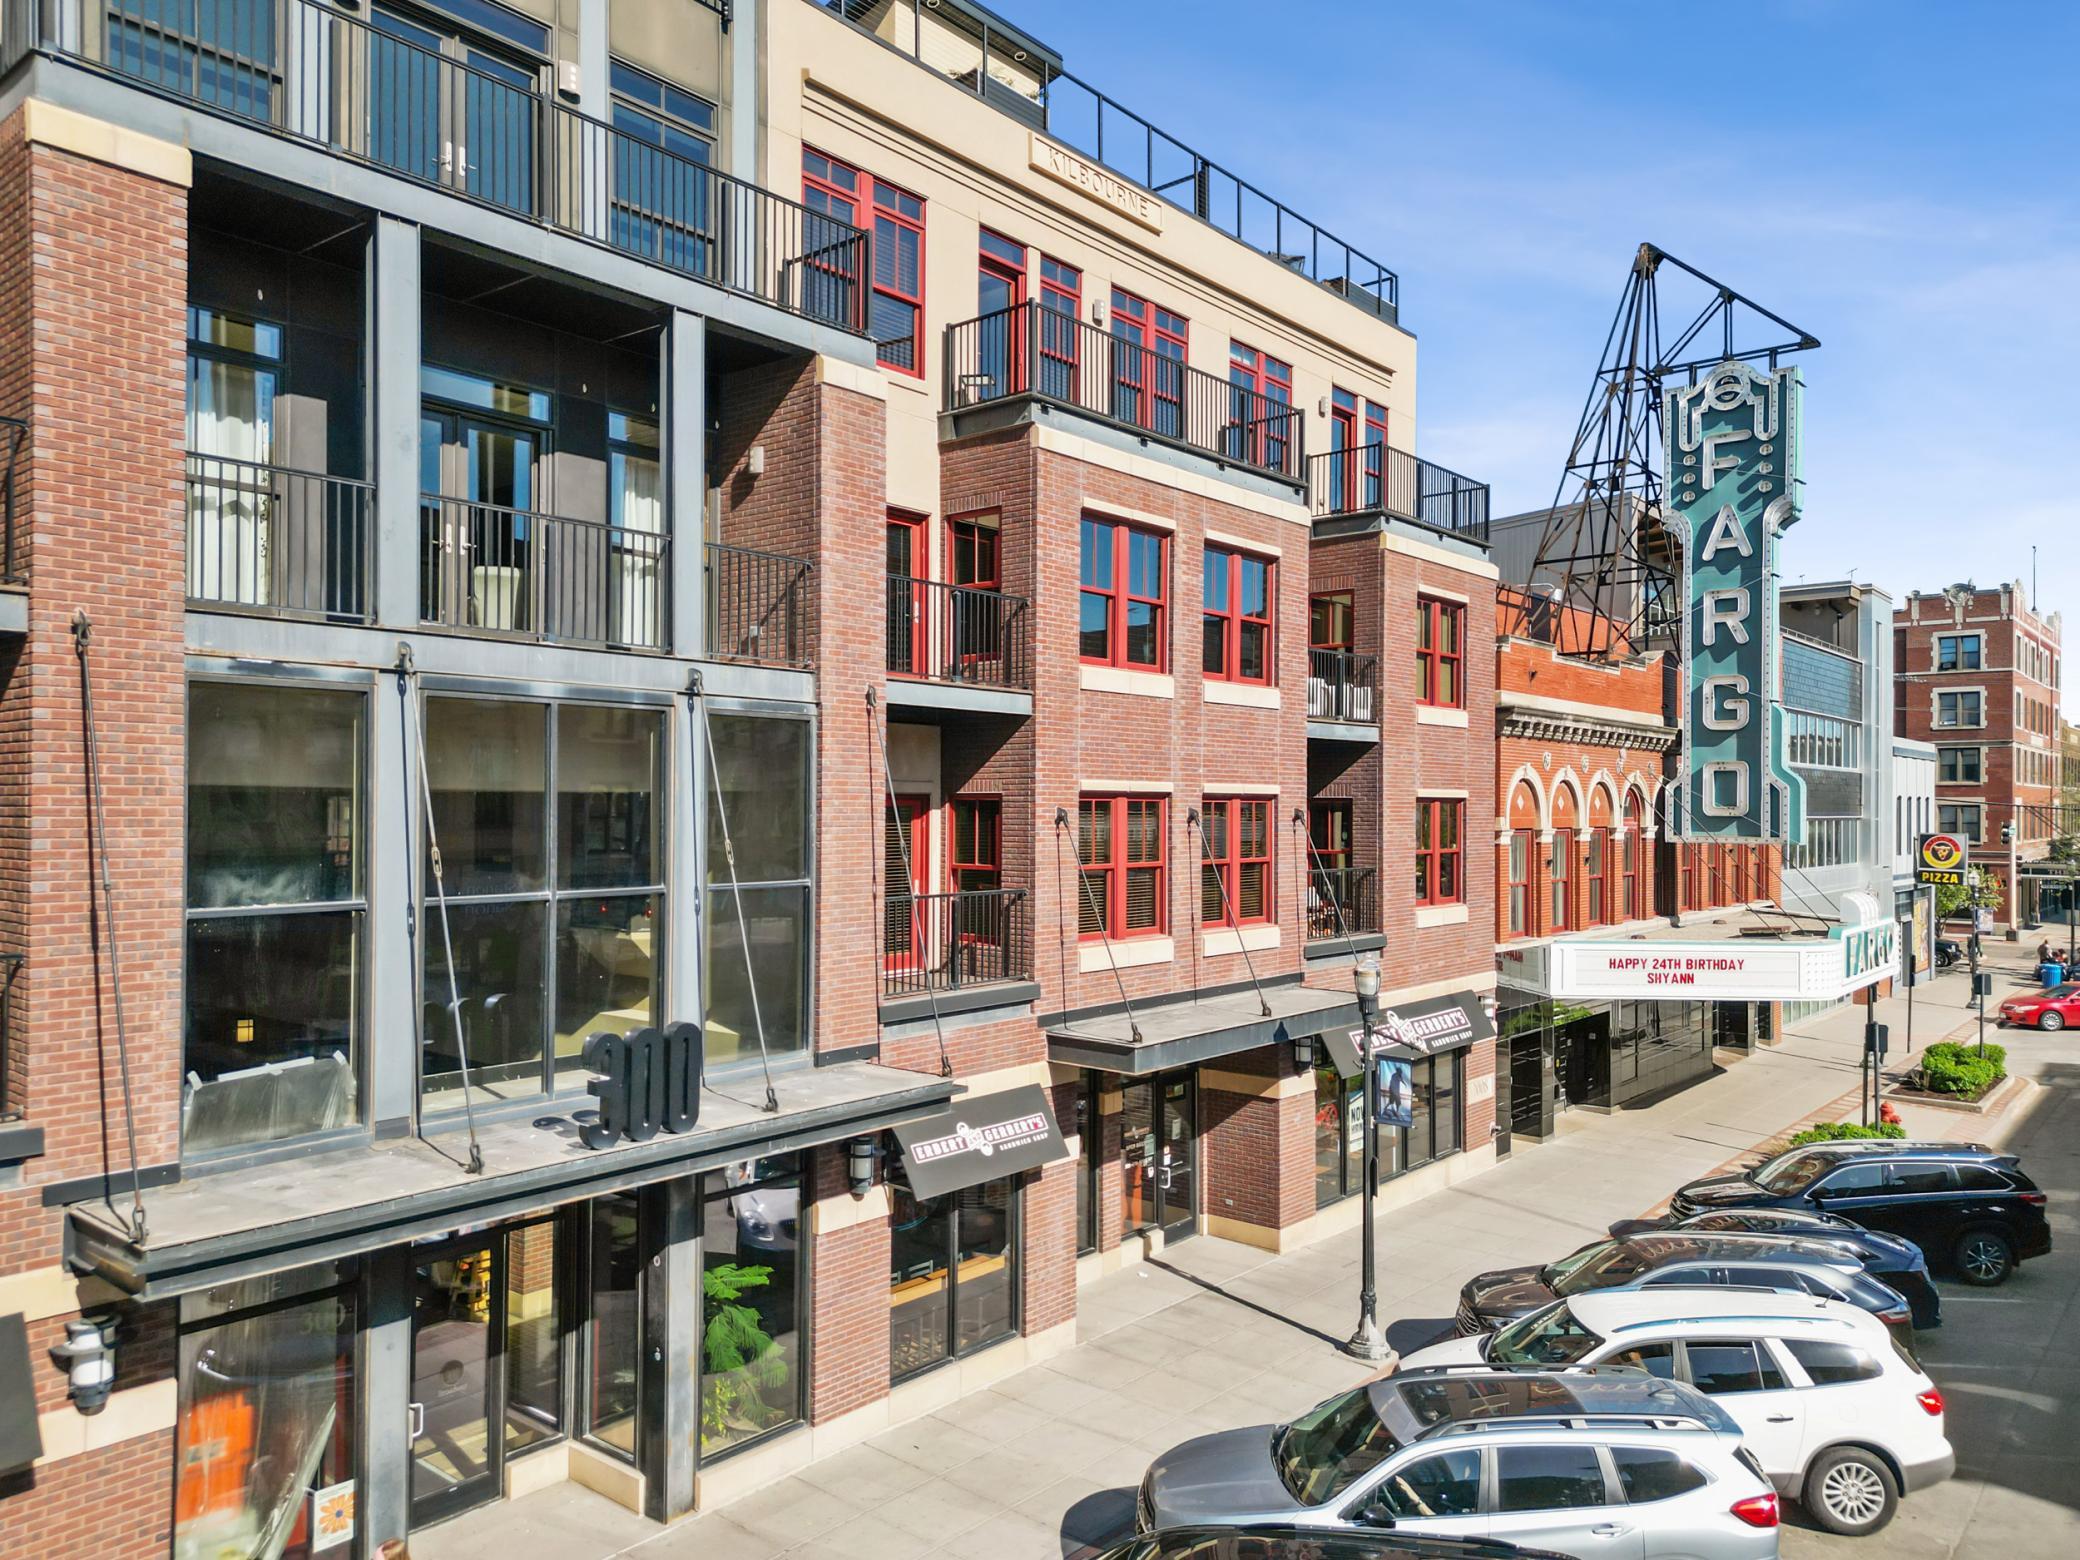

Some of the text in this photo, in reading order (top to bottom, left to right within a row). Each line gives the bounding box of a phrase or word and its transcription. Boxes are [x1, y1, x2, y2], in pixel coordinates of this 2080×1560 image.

[1049, 148, 1148, 218] KILBOURNE
[1702, 429, 1753, 817] FARGO
[1921, 871, 1959, 884] PIZZA
[1609, 958, 1744, 971] HAPPY 24TH BIRTHDAY
[1846, 924, 1894, 978] FARGO
[1647, 973, 1695, 985] SHYANN
[1354, 1027, 1398, 1049] EBERT
[1413, 1011, 1466, 1035] GERBERT'S
[578, 1020, 702, 1150] 300
[915, 1136, 966, 1160] ERBERT
[984, 1116, 1045, 1141] GERBERT'S
